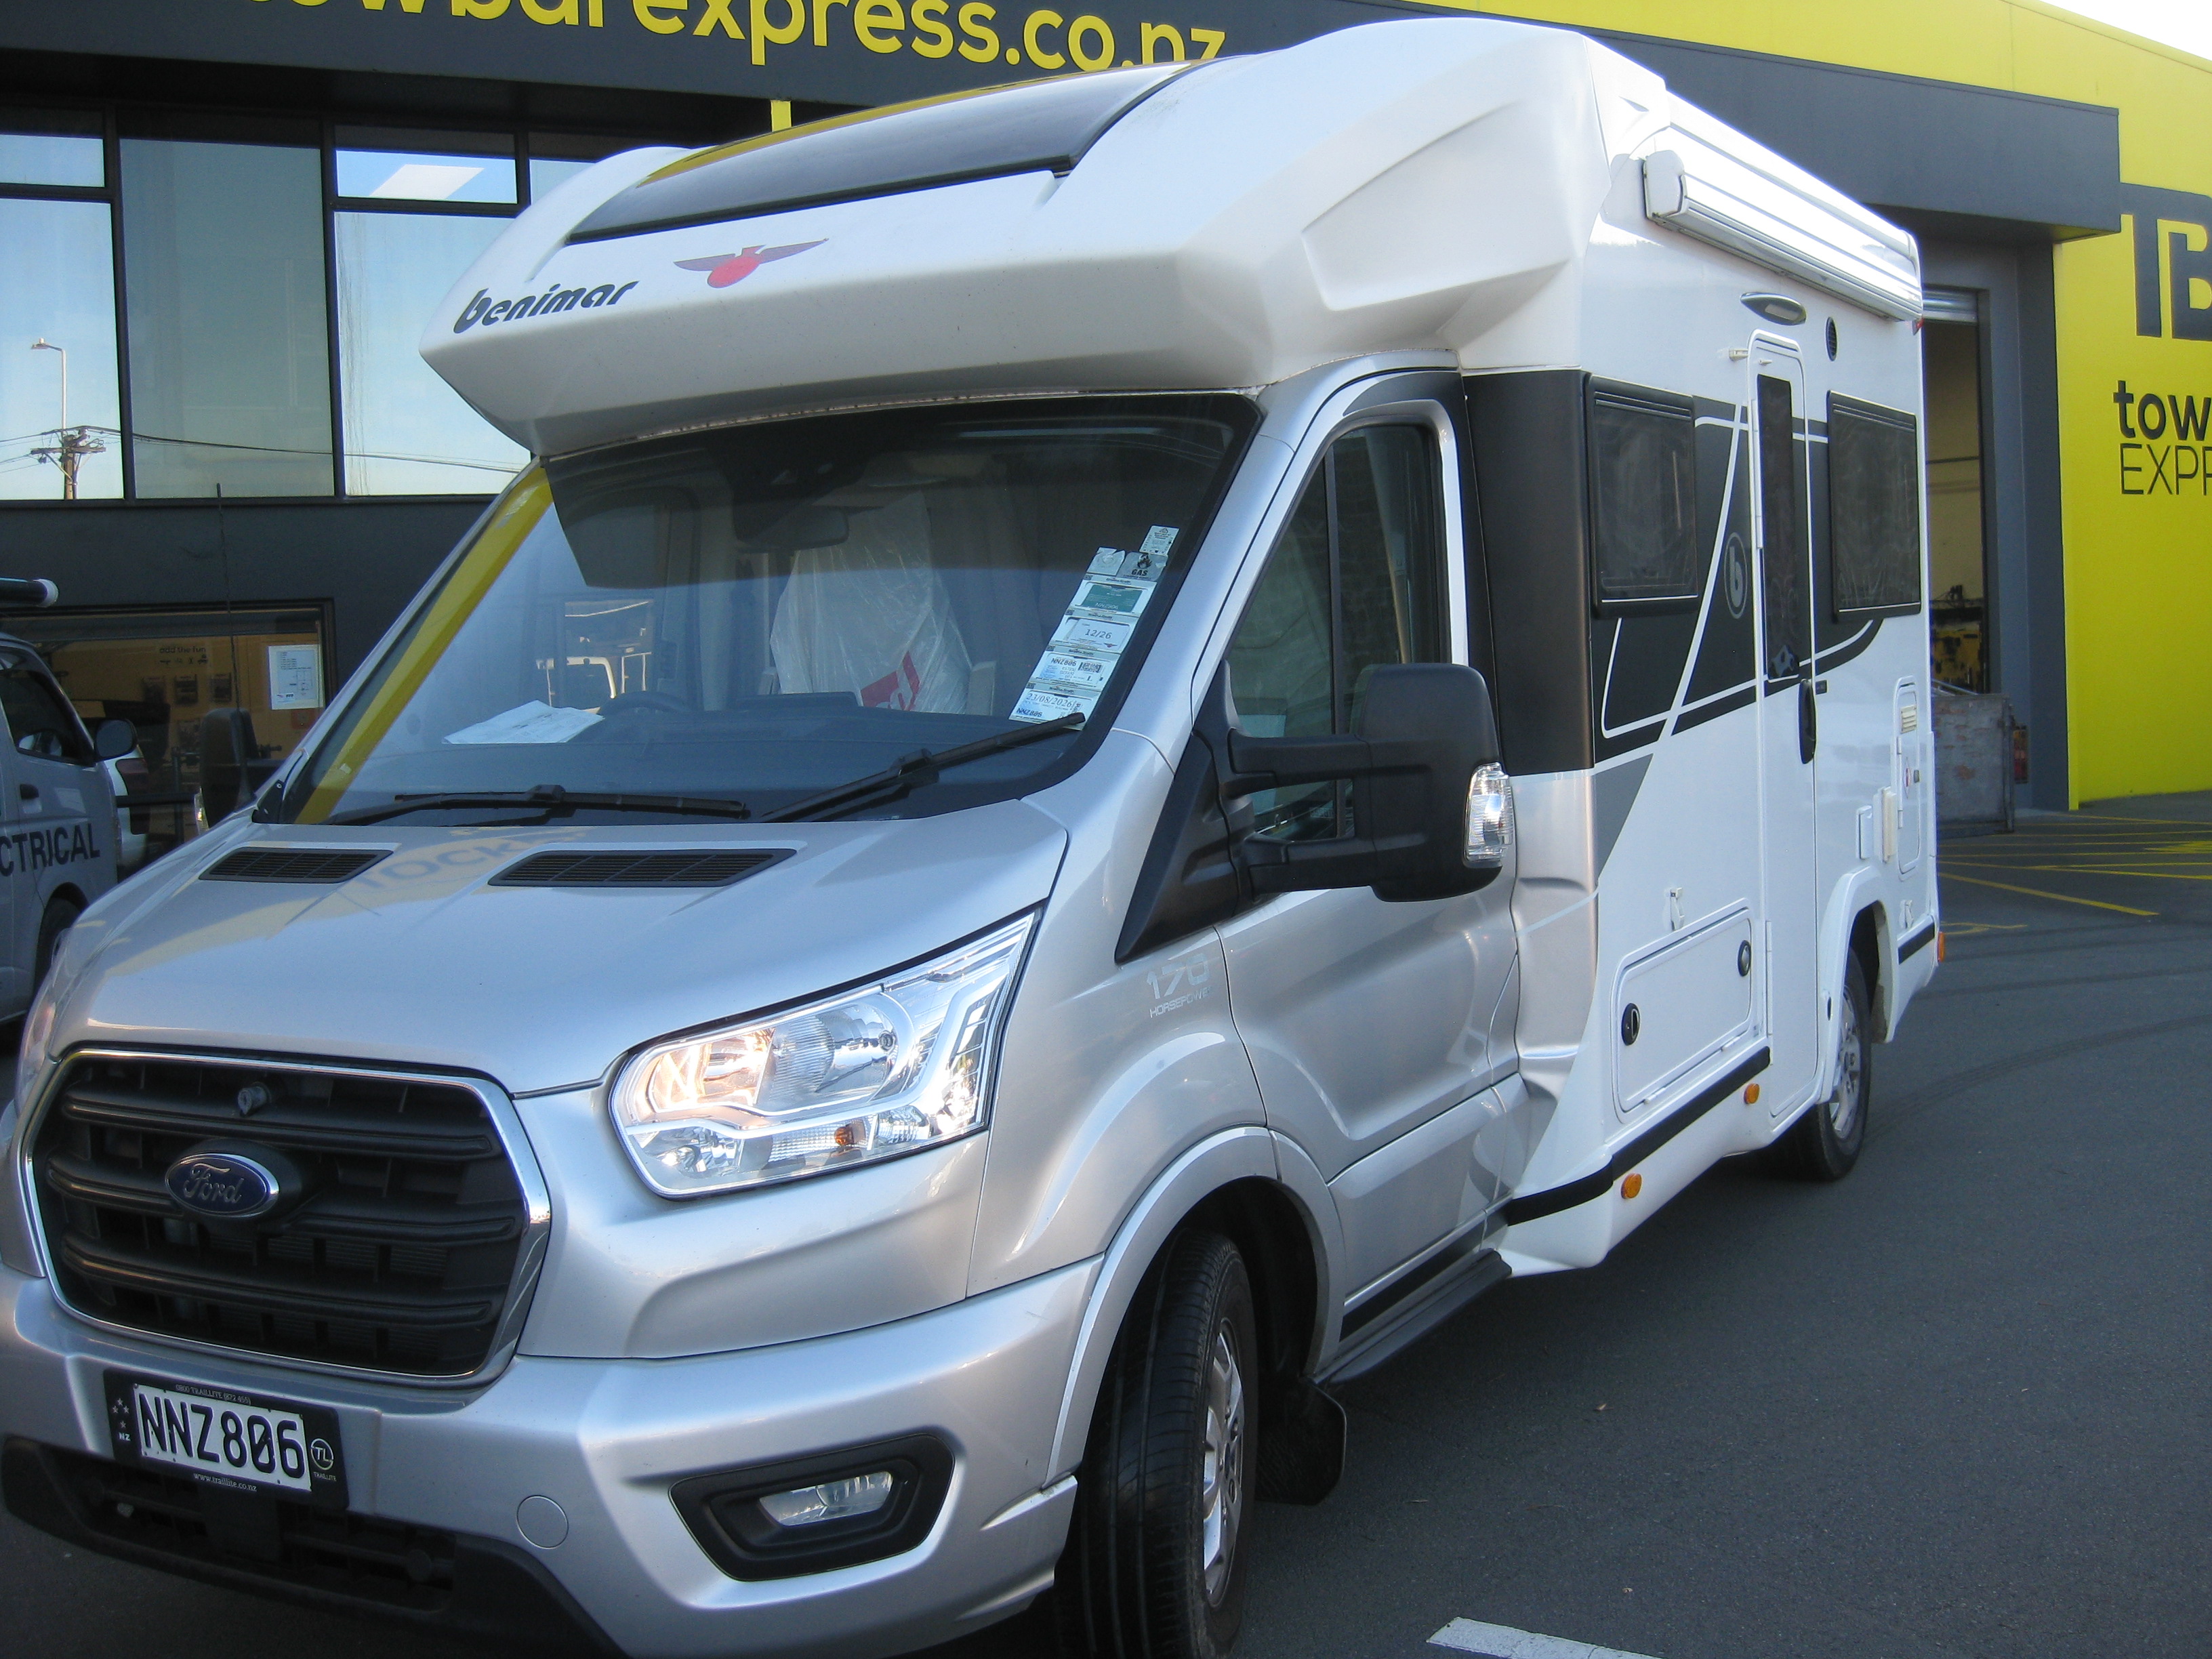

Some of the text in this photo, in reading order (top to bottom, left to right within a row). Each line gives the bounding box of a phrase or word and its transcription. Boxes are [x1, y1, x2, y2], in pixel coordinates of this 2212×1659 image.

[251, 0, 1225, 71] express.conz
[453, 280, 640, 334] benimar
[1085, 628, 1112, 639] 12/26
[1026, 692, 1073, 708] 23/08/2026
[0, 823, 101, 877] CTRICAL
[184, 1163, 245, 1204] Ford
[190, 1387, 223, 1399] TRAILLITE
[119, 1432, 131, 1441] NZ
[138, 1393, 306, 1479] NNZ806
[193, 1473, 258, 1492] www.traillite.co.nz
